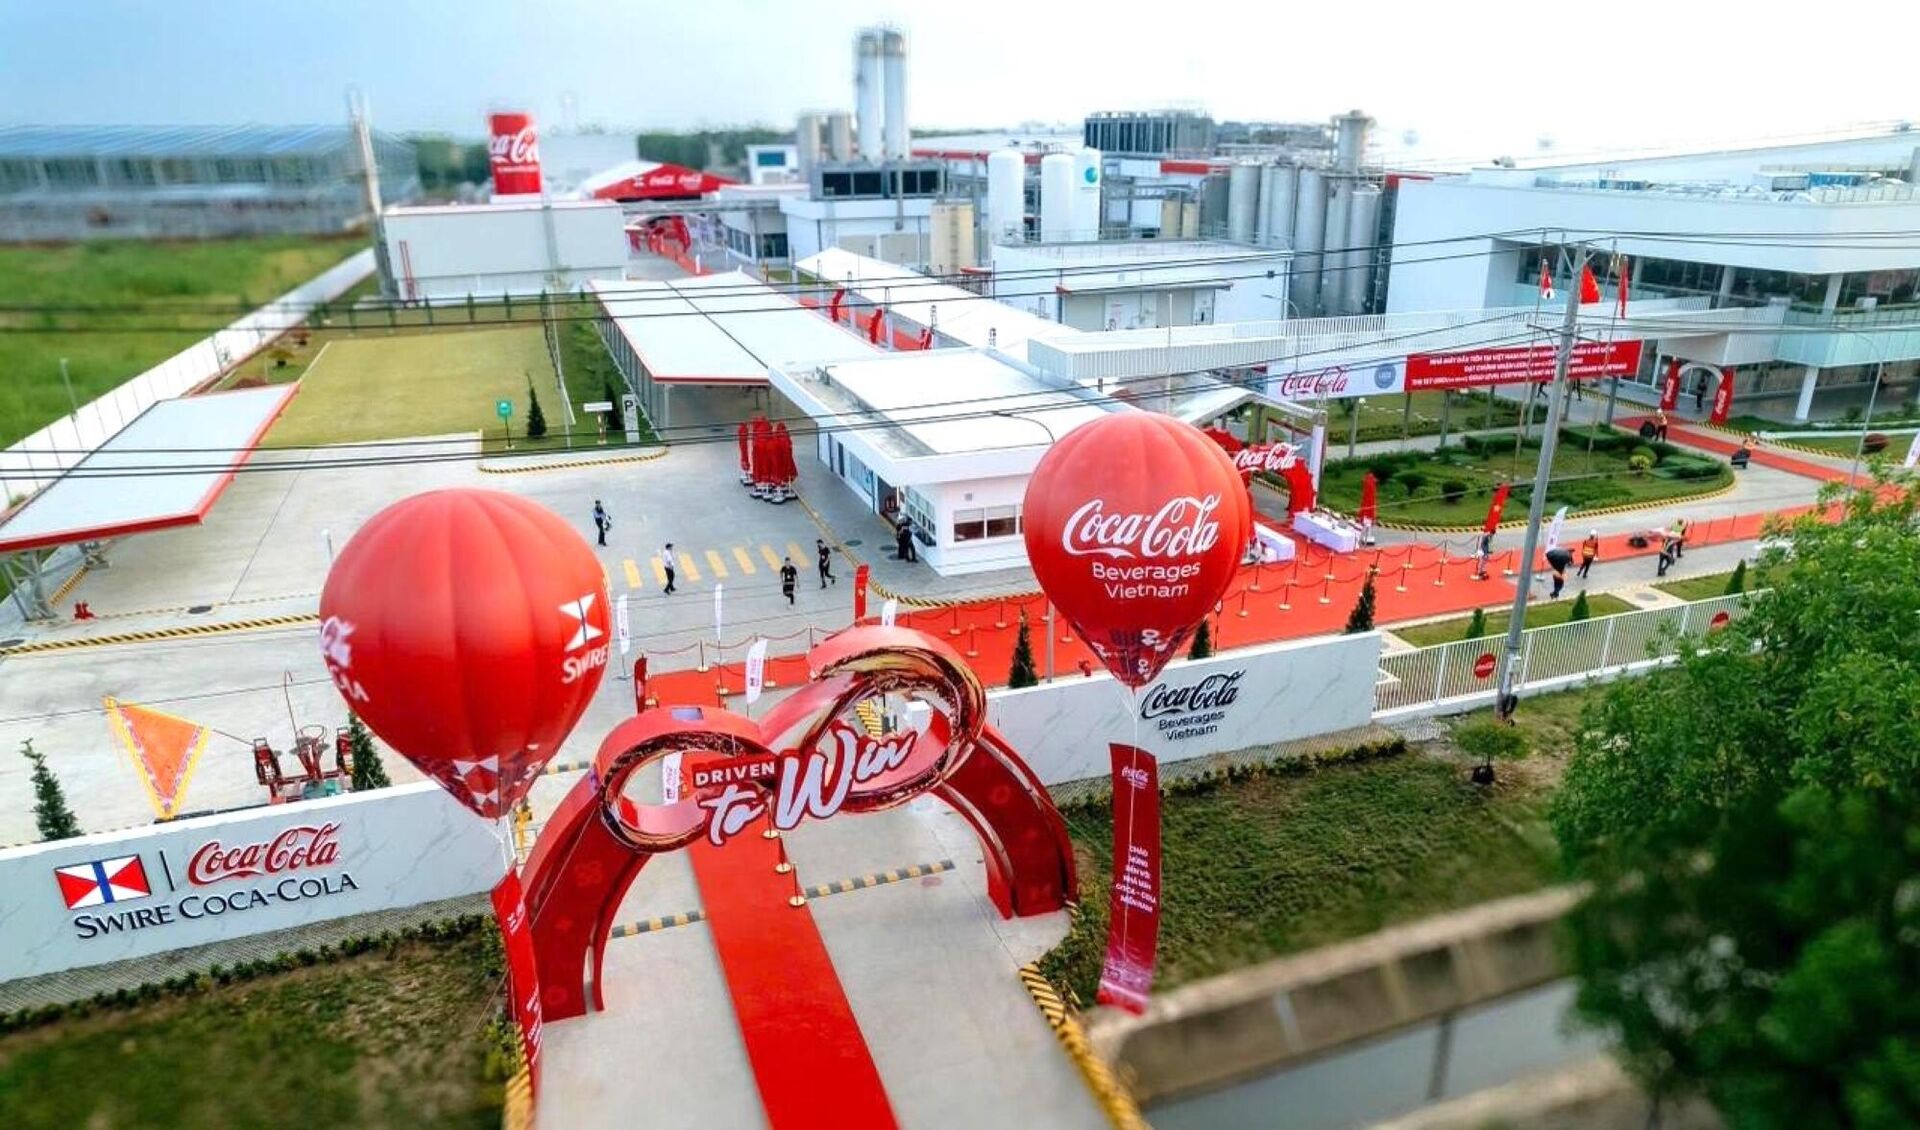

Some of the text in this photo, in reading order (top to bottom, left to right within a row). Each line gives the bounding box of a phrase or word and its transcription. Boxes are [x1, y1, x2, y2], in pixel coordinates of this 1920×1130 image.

[1281, 365, 1348, 396] Coca-Cola
[624, 399, 634, 412] P
[1234, 442, 1303, 473] Coca-Cola
[1062, 492, 1222, 559] Coca-Cola
[1092, 562, 1201, 583] Beverages
[1104, 582, 1189, 599] Vietnam
[1140, 669, 1247, 719] Coca-Cola
[1159, 710, 1225, 731] Beverages
[1165, 724, 1218, 741] Vietnam
[695, 761, 776, 786] DRIVEN
[699, 729, 917, 846] to Win
[187, 821, 342, 886] Coca-Cola
[74, 873, 360, 939] SWIRE COCA-COLA
